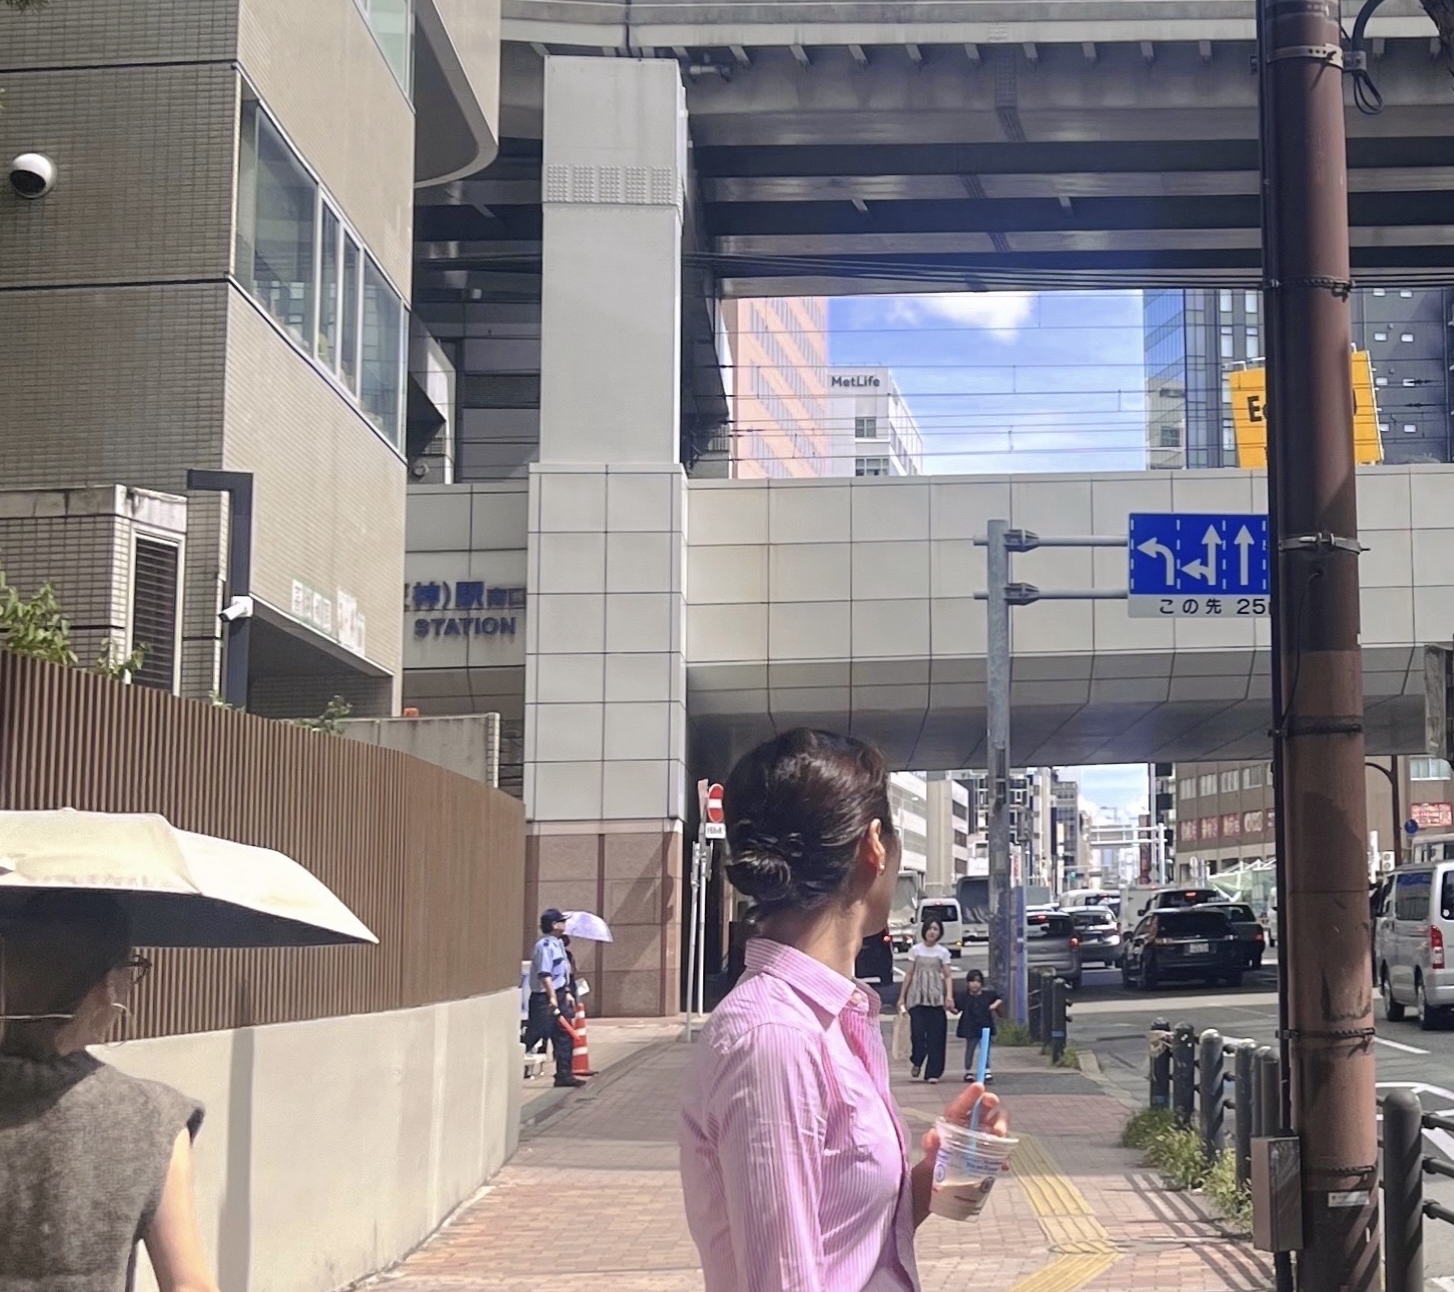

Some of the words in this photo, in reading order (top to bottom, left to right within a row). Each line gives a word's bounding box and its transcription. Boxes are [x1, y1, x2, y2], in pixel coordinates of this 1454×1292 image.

[831, 374, 881, 388] MetLife
[1159, 598, 1222, 615] この先
[413, 616, 518, 637] STATION
